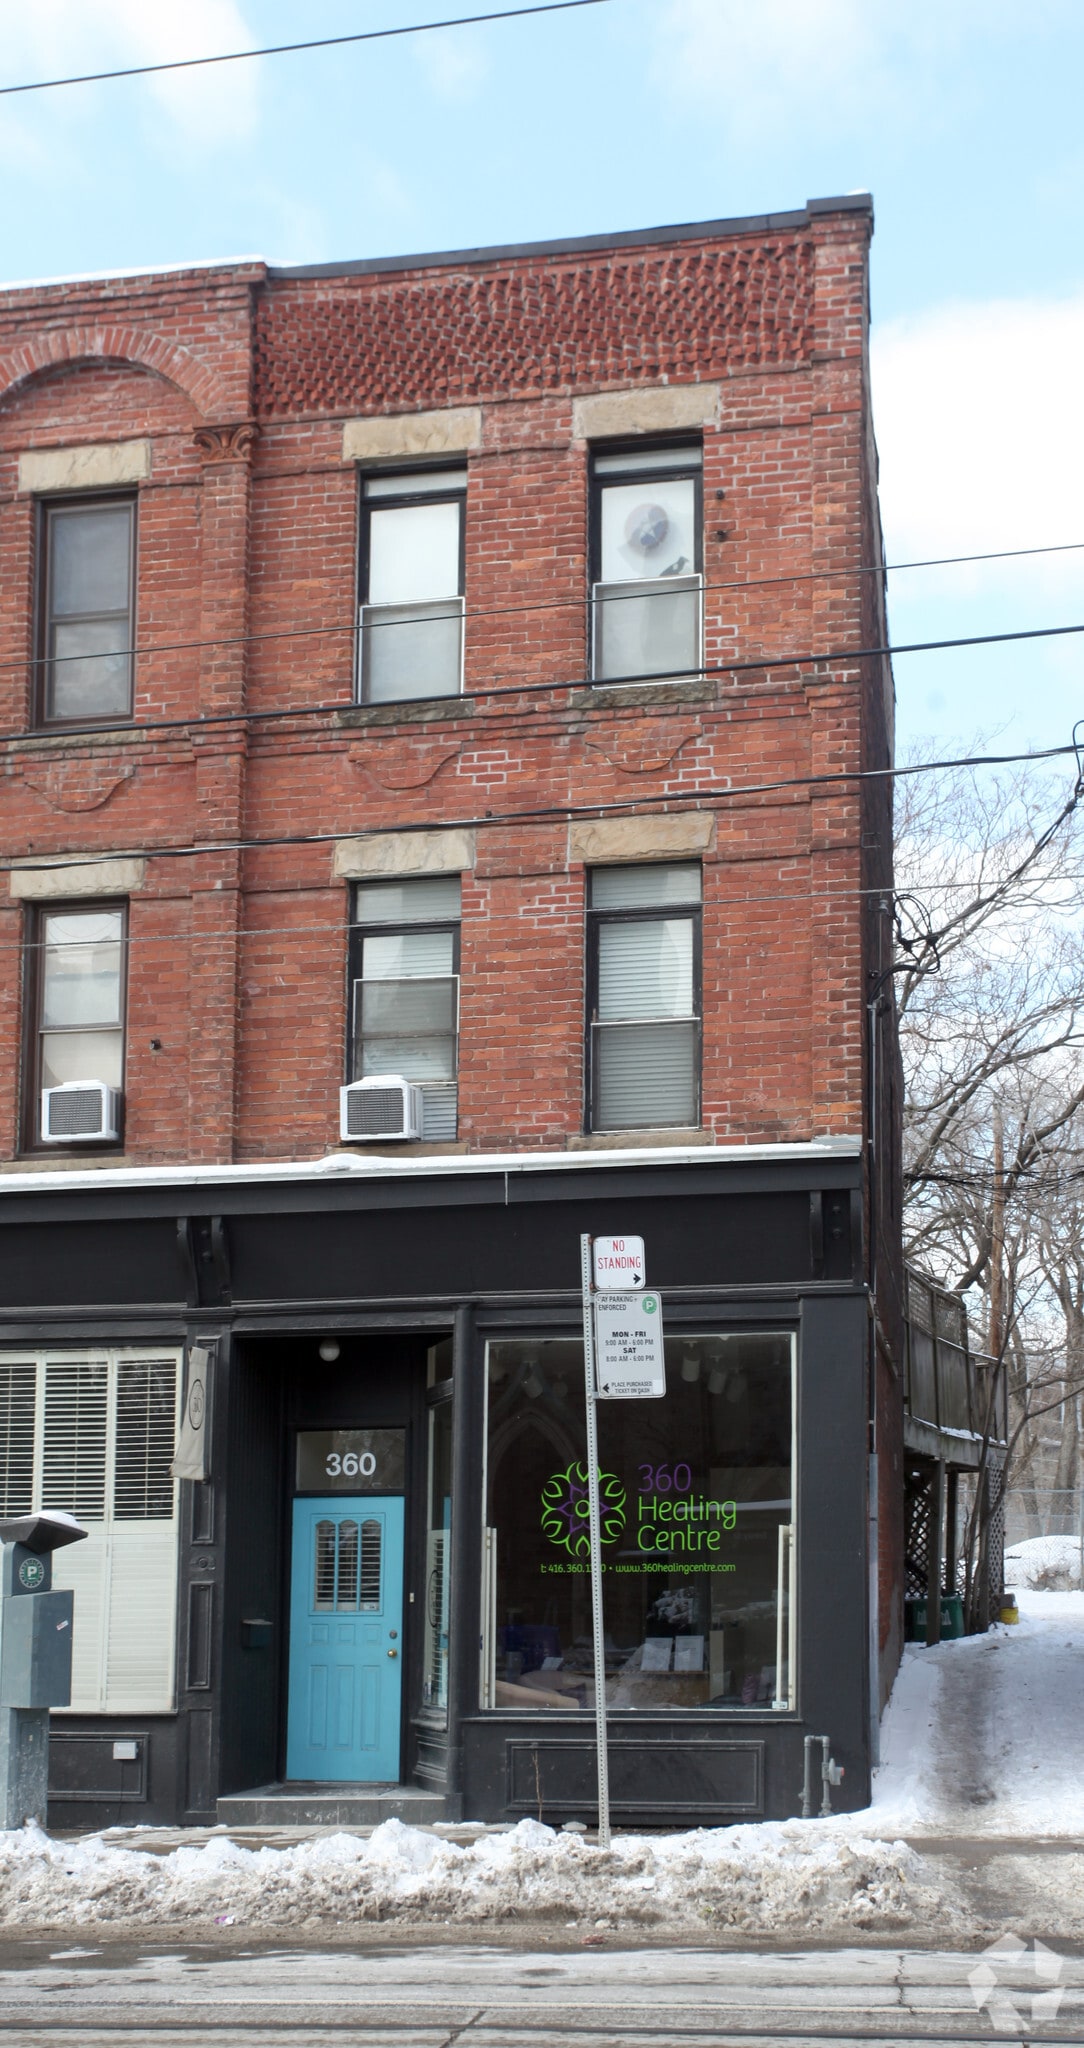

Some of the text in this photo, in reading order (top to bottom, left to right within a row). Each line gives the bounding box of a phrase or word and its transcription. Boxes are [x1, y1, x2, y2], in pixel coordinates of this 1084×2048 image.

[612, 1239, 625, 1252] NO
[598, 1256, 641, 1270] STANDING
[634, 1330, 647, 1338] FRI
[325, 1452, 377, 1477] 360
[637, 1463, 692, 1492] 360
[638, 1494, 737, 1529] Healing
[637, 1524, 721, 1551] Centre
[548, 1564, 607, 1573] 416.360.10
[615, 1562, 736, 1575] www.360healingcentre.com
